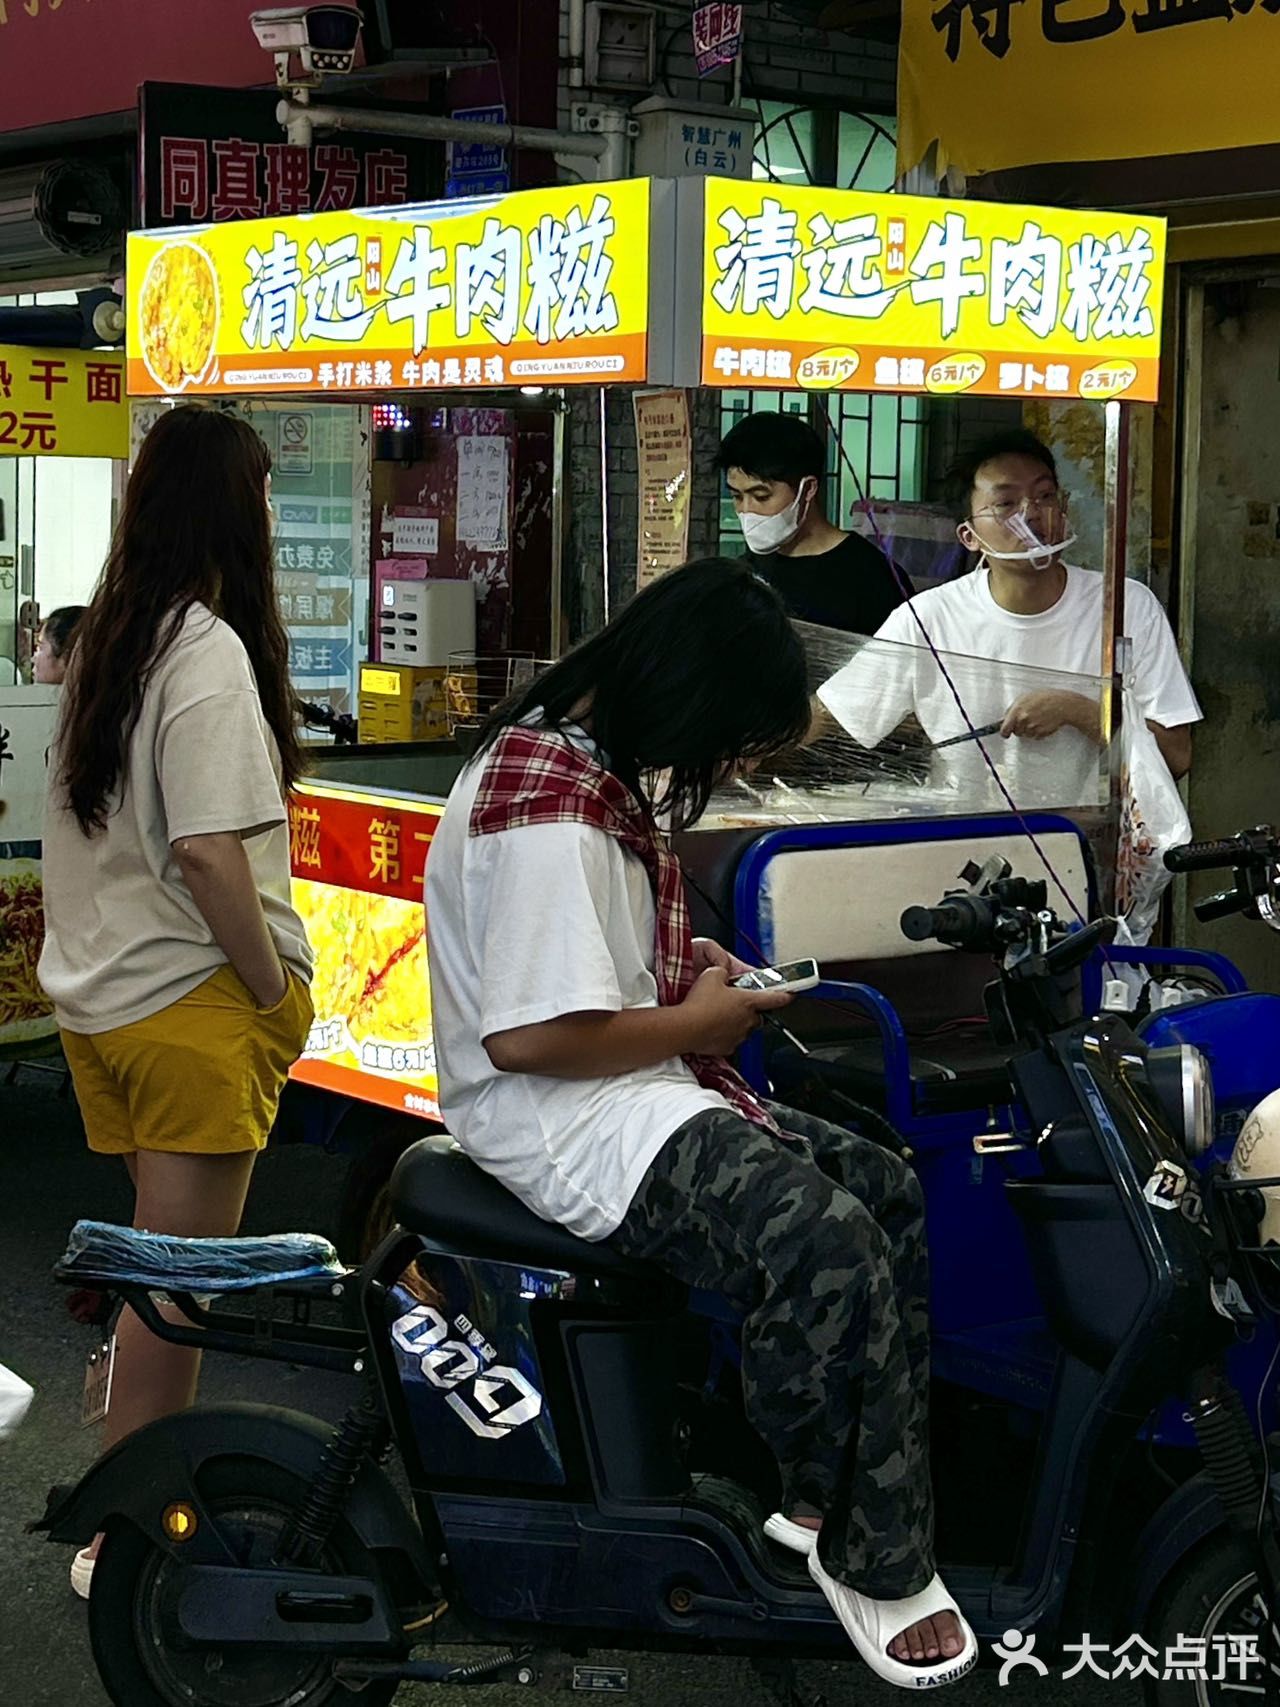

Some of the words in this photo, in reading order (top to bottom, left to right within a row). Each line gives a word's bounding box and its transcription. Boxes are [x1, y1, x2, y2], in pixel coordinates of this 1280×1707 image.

[681, 124, 742, 149] 智慧广州
[160, 136, 408, 220] 同真理发店
[240, 193, 619, 357] 清远牛肉糍
[711, 197, 1155, 340] 清远牛肉糍
[317, 361, 392, 387] 手打米浆
[403, 356, 504, 385] 牛肉是灵魂
[801, 359, 855, 378] 8元/个
[930, 364, 980, 384] 6元/个
[1083, 371, 1132, 389] 2元/个
